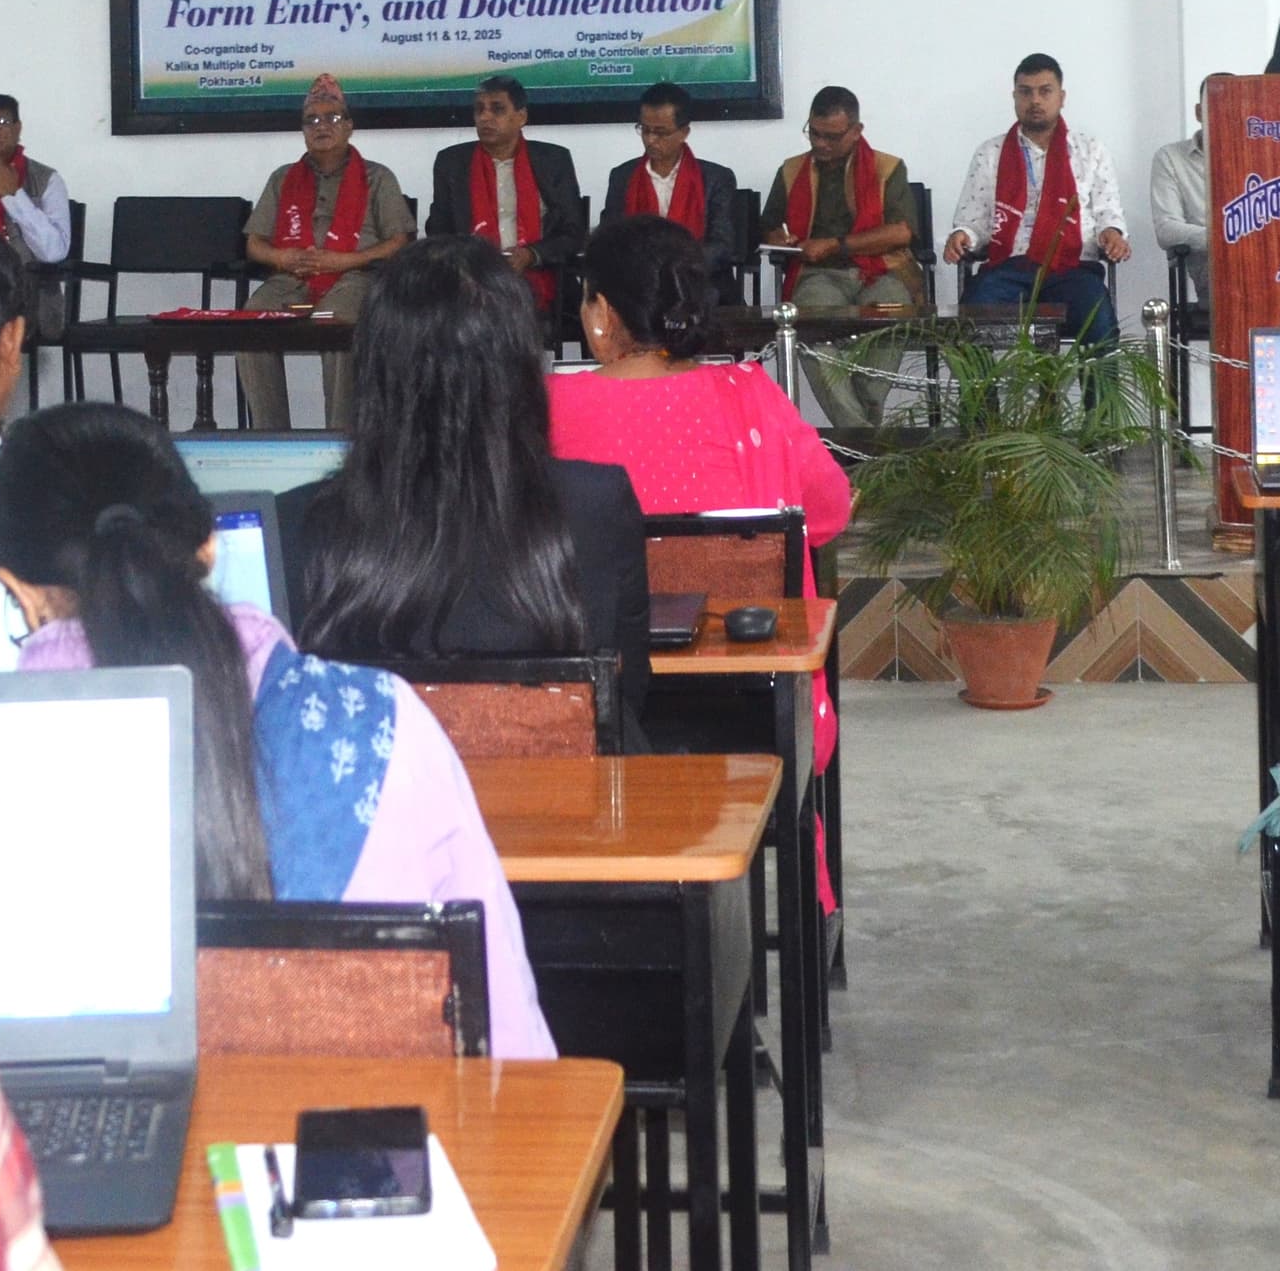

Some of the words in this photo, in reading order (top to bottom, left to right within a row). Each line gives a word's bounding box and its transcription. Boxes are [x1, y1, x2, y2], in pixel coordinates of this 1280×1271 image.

[381, 31, 422, 44] August
[425, 31, 439, 42] 11
[442, 31, 451, 42] &
[454, 29, 471, 43] 12,
[474, 29, 502, 40] 2025
[576, 30, 628, 44] Organized
[631, 29, 643, 42] by
[184, 44, 258, 58] Co-organized
[261, 43, 274, 56] by
[488, 49, 532, 62] Regional
[535, 48, 565, 60] Office
[567, 47, 577, 58] of
[580, 47, 596, 58] the
[599, 46, 650, 58] Controller
[653, 45, 663, 56] of
[664, 43, 734, 56] Examinations
[166, 61, 199, 72] Kalika
[203, 59, 246, 72] Multiple
[249, 59, 295, 72] Campus
[590, 64, 632, 75] Pokhara
[199, 75, 261, 88] Pokhara-14
